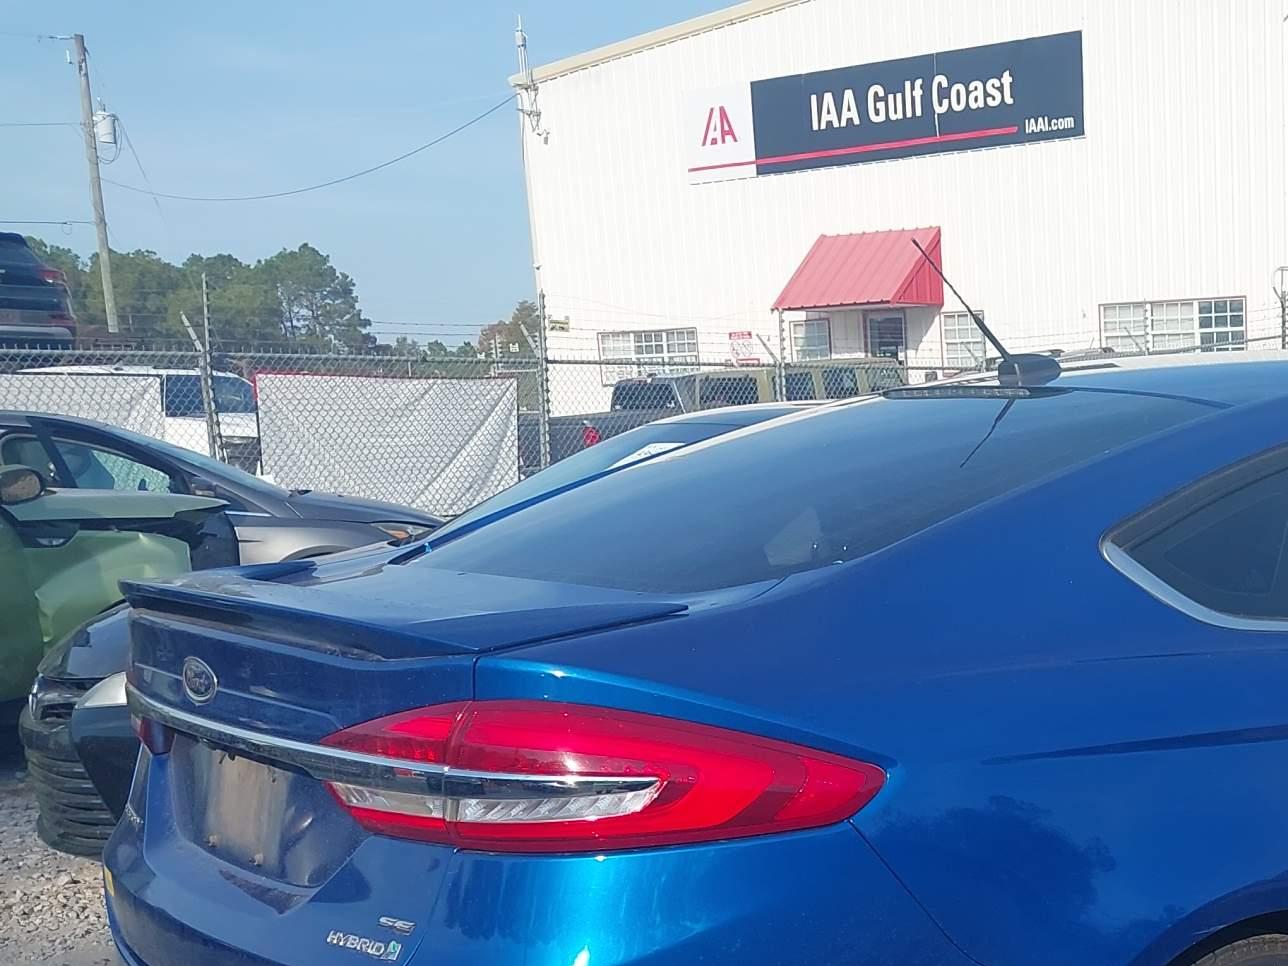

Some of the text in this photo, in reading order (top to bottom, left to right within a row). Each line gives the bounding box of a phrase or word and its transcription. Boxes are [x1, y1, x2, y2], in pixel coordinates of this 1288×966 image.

[810, 69, 1014, 131] IAA Gulf Coast
[1024, 116, 1075, 134] IAAI.com
[379, 916, 416, 936] SE
[326, 930, 385, 956] HYBRID
